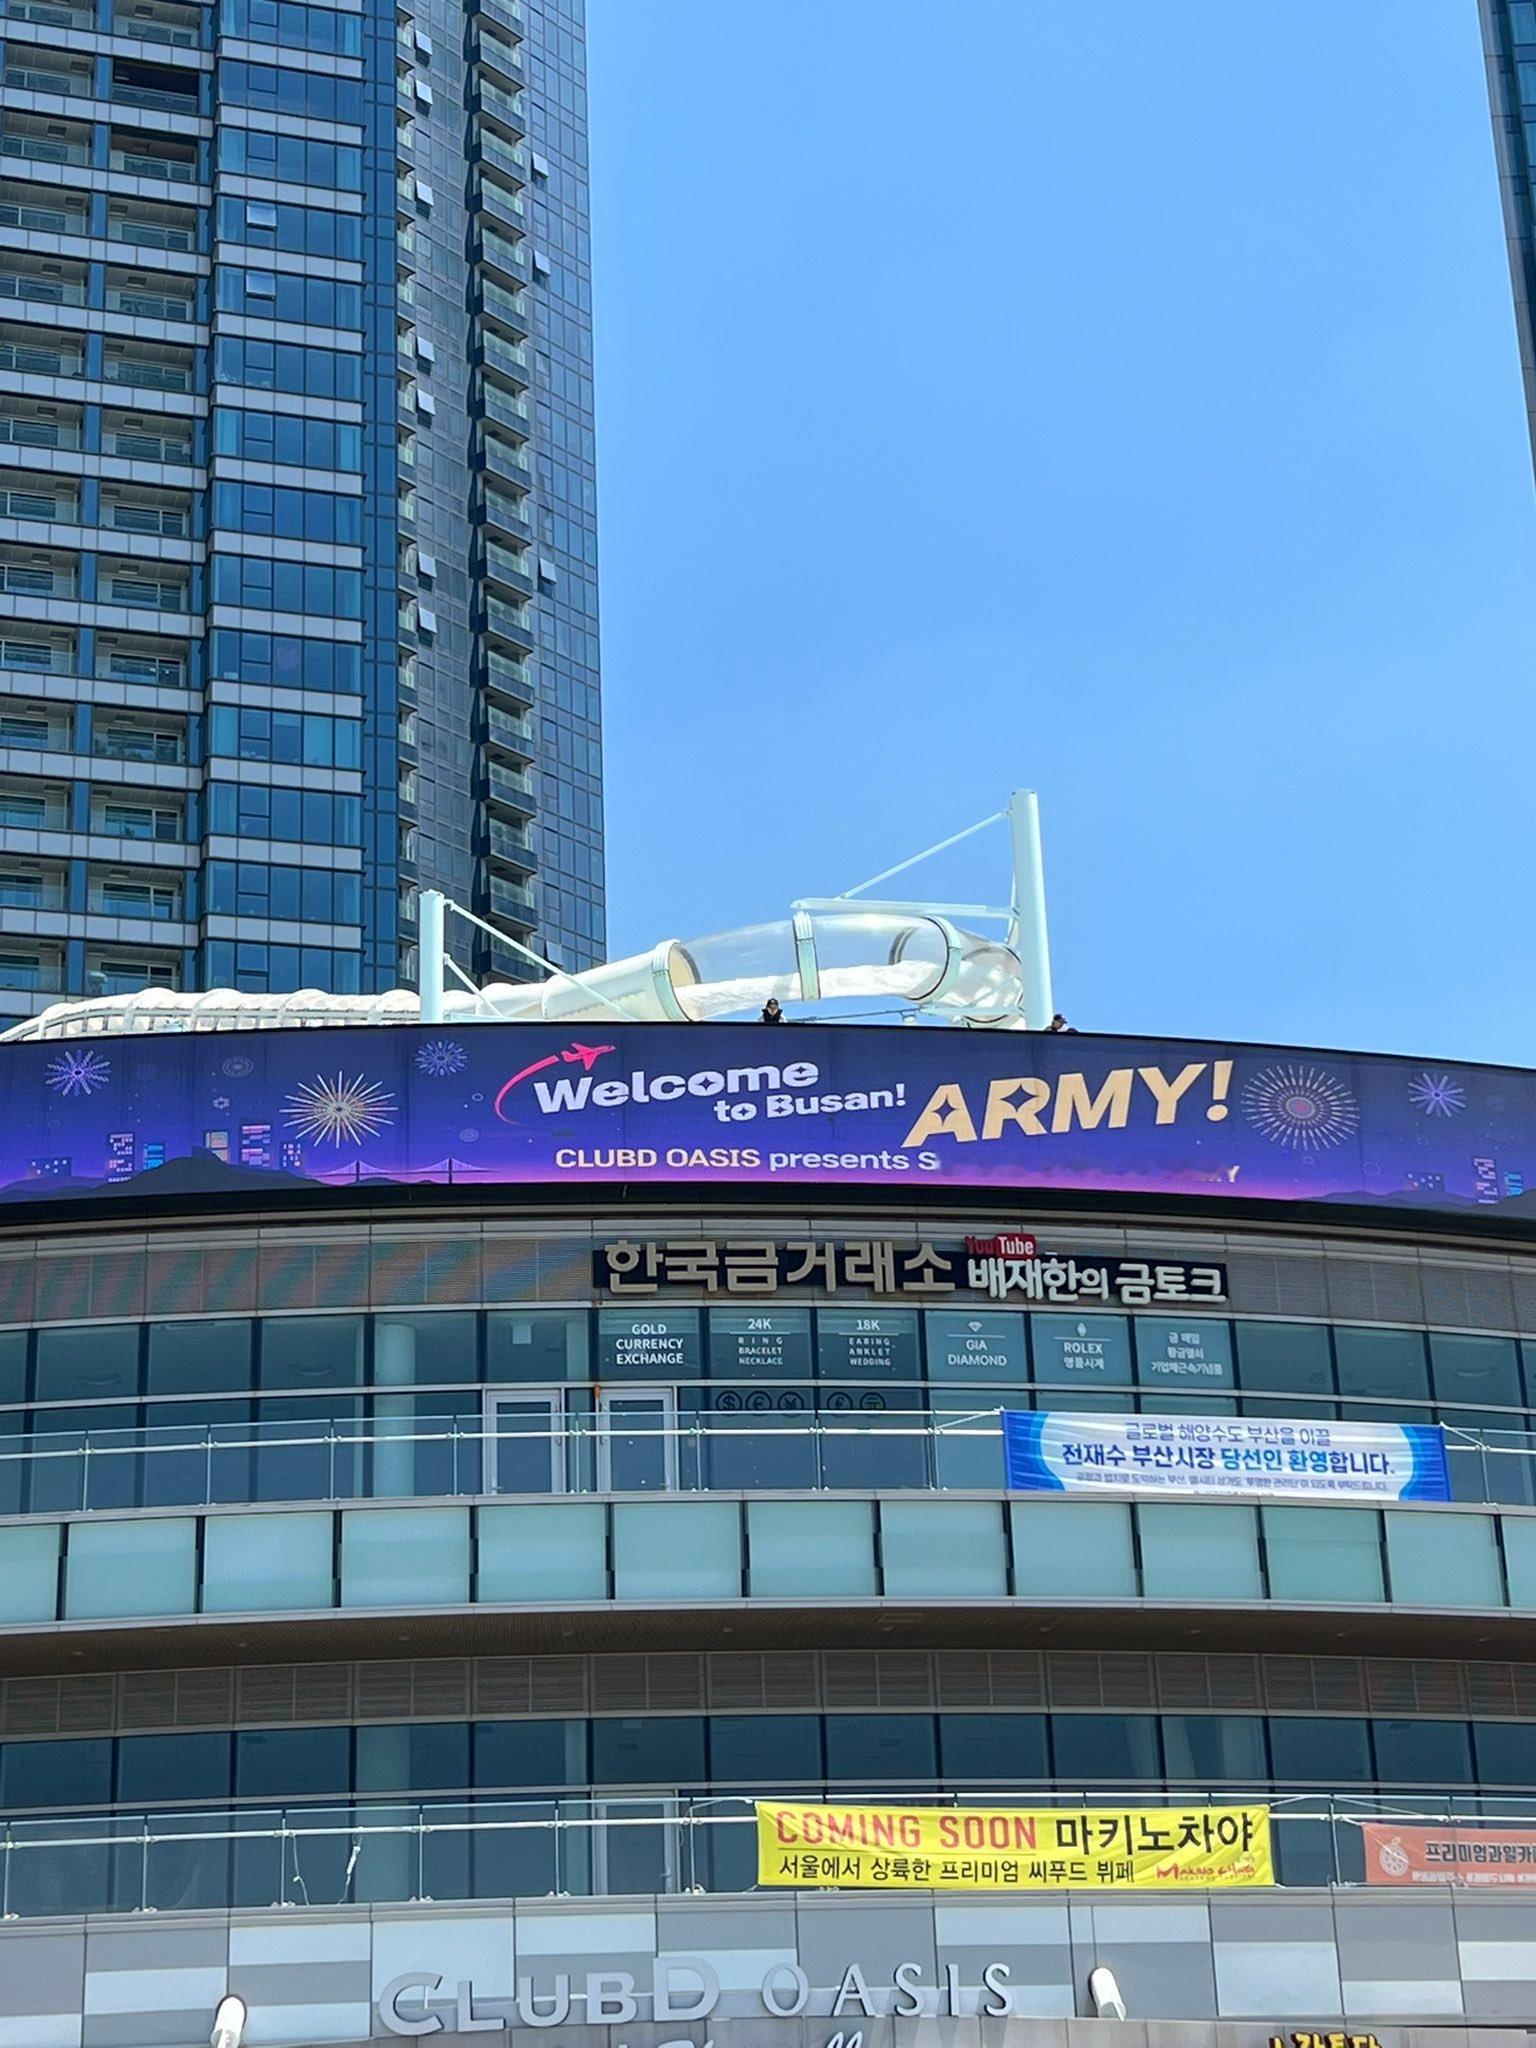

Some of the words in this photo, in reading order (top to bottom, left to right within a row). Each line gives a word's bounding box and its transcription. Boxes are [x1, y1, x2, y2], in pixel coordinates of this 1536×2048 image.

[533, 1061, 819, 1114] Welcome
[714, 1100, 757, 1122] to
[766, 1083, 906, 1119] Busan!
[900, 1060, 1233, 1148] ARMY!
[555, 1148, 657, 1169] CLUBD
[666, 1148, 761, 1169] OASIS
[770, 1151, 909, 1173] presents
[964, 1235, 1036, 1256] YouTube
[604, 1240, 956, 1294] 한국금거래소
[968, 1257, 1110, 1301] 배재한의
[1115, 1263, 1227, 1304] 금토크
[632, 1323, 667, 1335] GOLD
[747, 1318, 773, 1330] 24K
[856, 1319, 880, 1331] 18K
[616, 1338, 684, 1350] CURRENCY
[738, 1347, 783, 1355] BRACELET
[966, 1340, 988, 1351] GIA
[1064, 1342, 1104, 1356] ROLEX
[616, 1352, 684, 1365] EXCHANGE
[738, 1357, 783, 1365] NECKLACE
[850, 1358, 891, 1366] WEDDING
[947, 1354, 1007, 1366] DIAMOND
[1064, 1357, 1105, 1370] 명품시계
[1126, 1422, 1174, 1441] 글로벌
[1178, 1424, 1242, 1443] 해양수도
[1247, 1426, 1295, 1445] 부산을
[1062, 1443, 1126, 1466] 전재수
[1132, 1445, 1216, 1469] 부산시장
[1221, 1448, 1283, 1471] 당선인
[1287, 1449, 1396, 1474] 환영합니다.
[776, 1811, 921, 1847] COMING
[939, 1815, 1037, 1850] SOON
[1056, 1812, 1253, 1855] 마키노차야
[1426, 1842, 1536, 1864] 프리미엄과일카
[779, 1855, 861, 1880] 서울에서
[871, 1858, 931, 1881] 상륙한
[940, 1860, 1019, 1883] 프리미엄
[1029, 1860, 1087, 1883] 씨푸드
[1097, 1860, 1134, 1883] 뷔페
[378, 1957, 719, 2036] CLUBD
[762, 1962, 1016, 2018] OASIS
